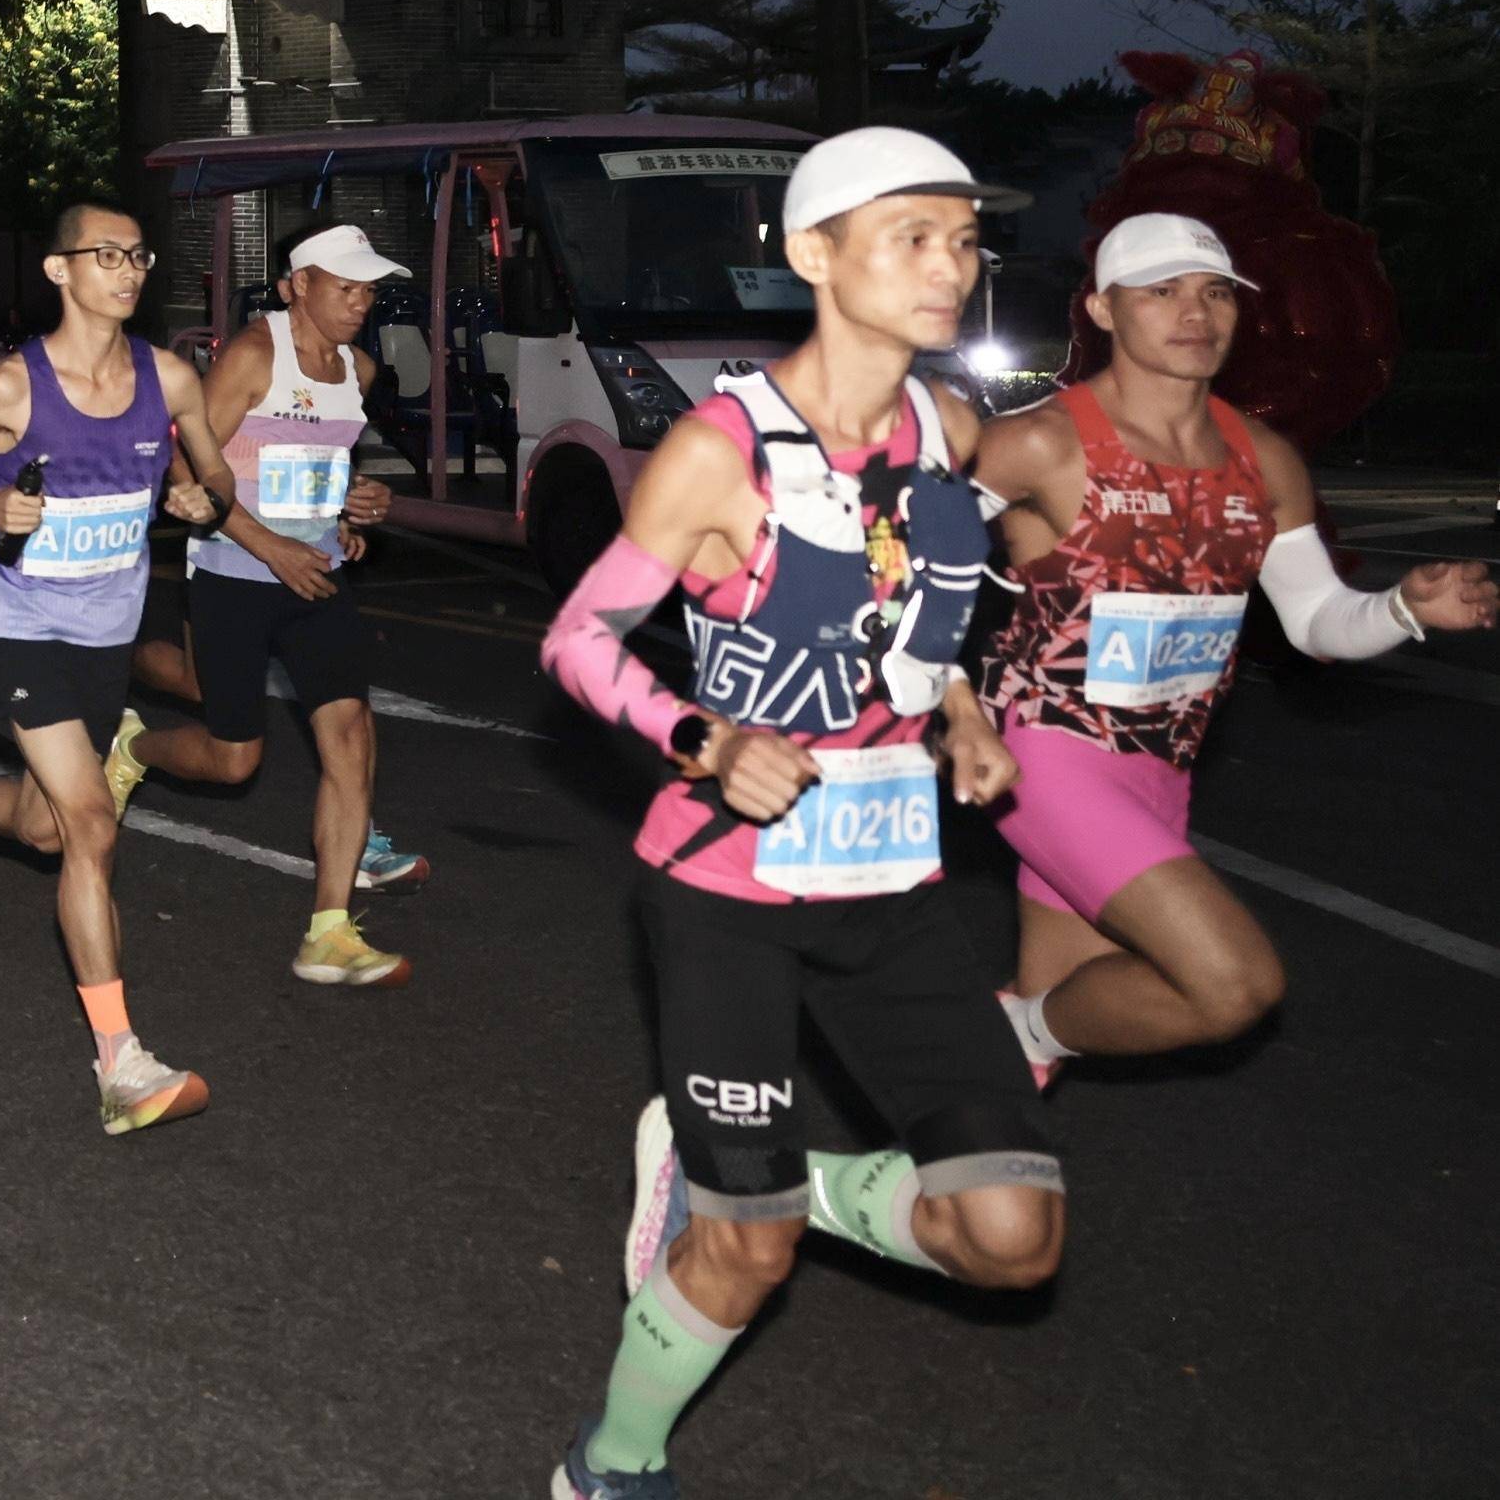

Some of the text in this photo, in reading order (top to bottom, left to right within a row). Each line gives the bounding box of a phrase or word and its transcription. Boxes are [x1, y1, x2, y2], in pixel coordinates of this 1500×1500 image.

[265, 466, 286, 496] T
[32, 518, 143, 552] A 0100
[1097, 628, 1238, 671] A 0238
[767, 794, 931, 851] A 0216
[686, 1074, 793, 1114] CBN
[738, 1111, 772, 1128] Club
[637, 1312, 674, 1351] BAY
